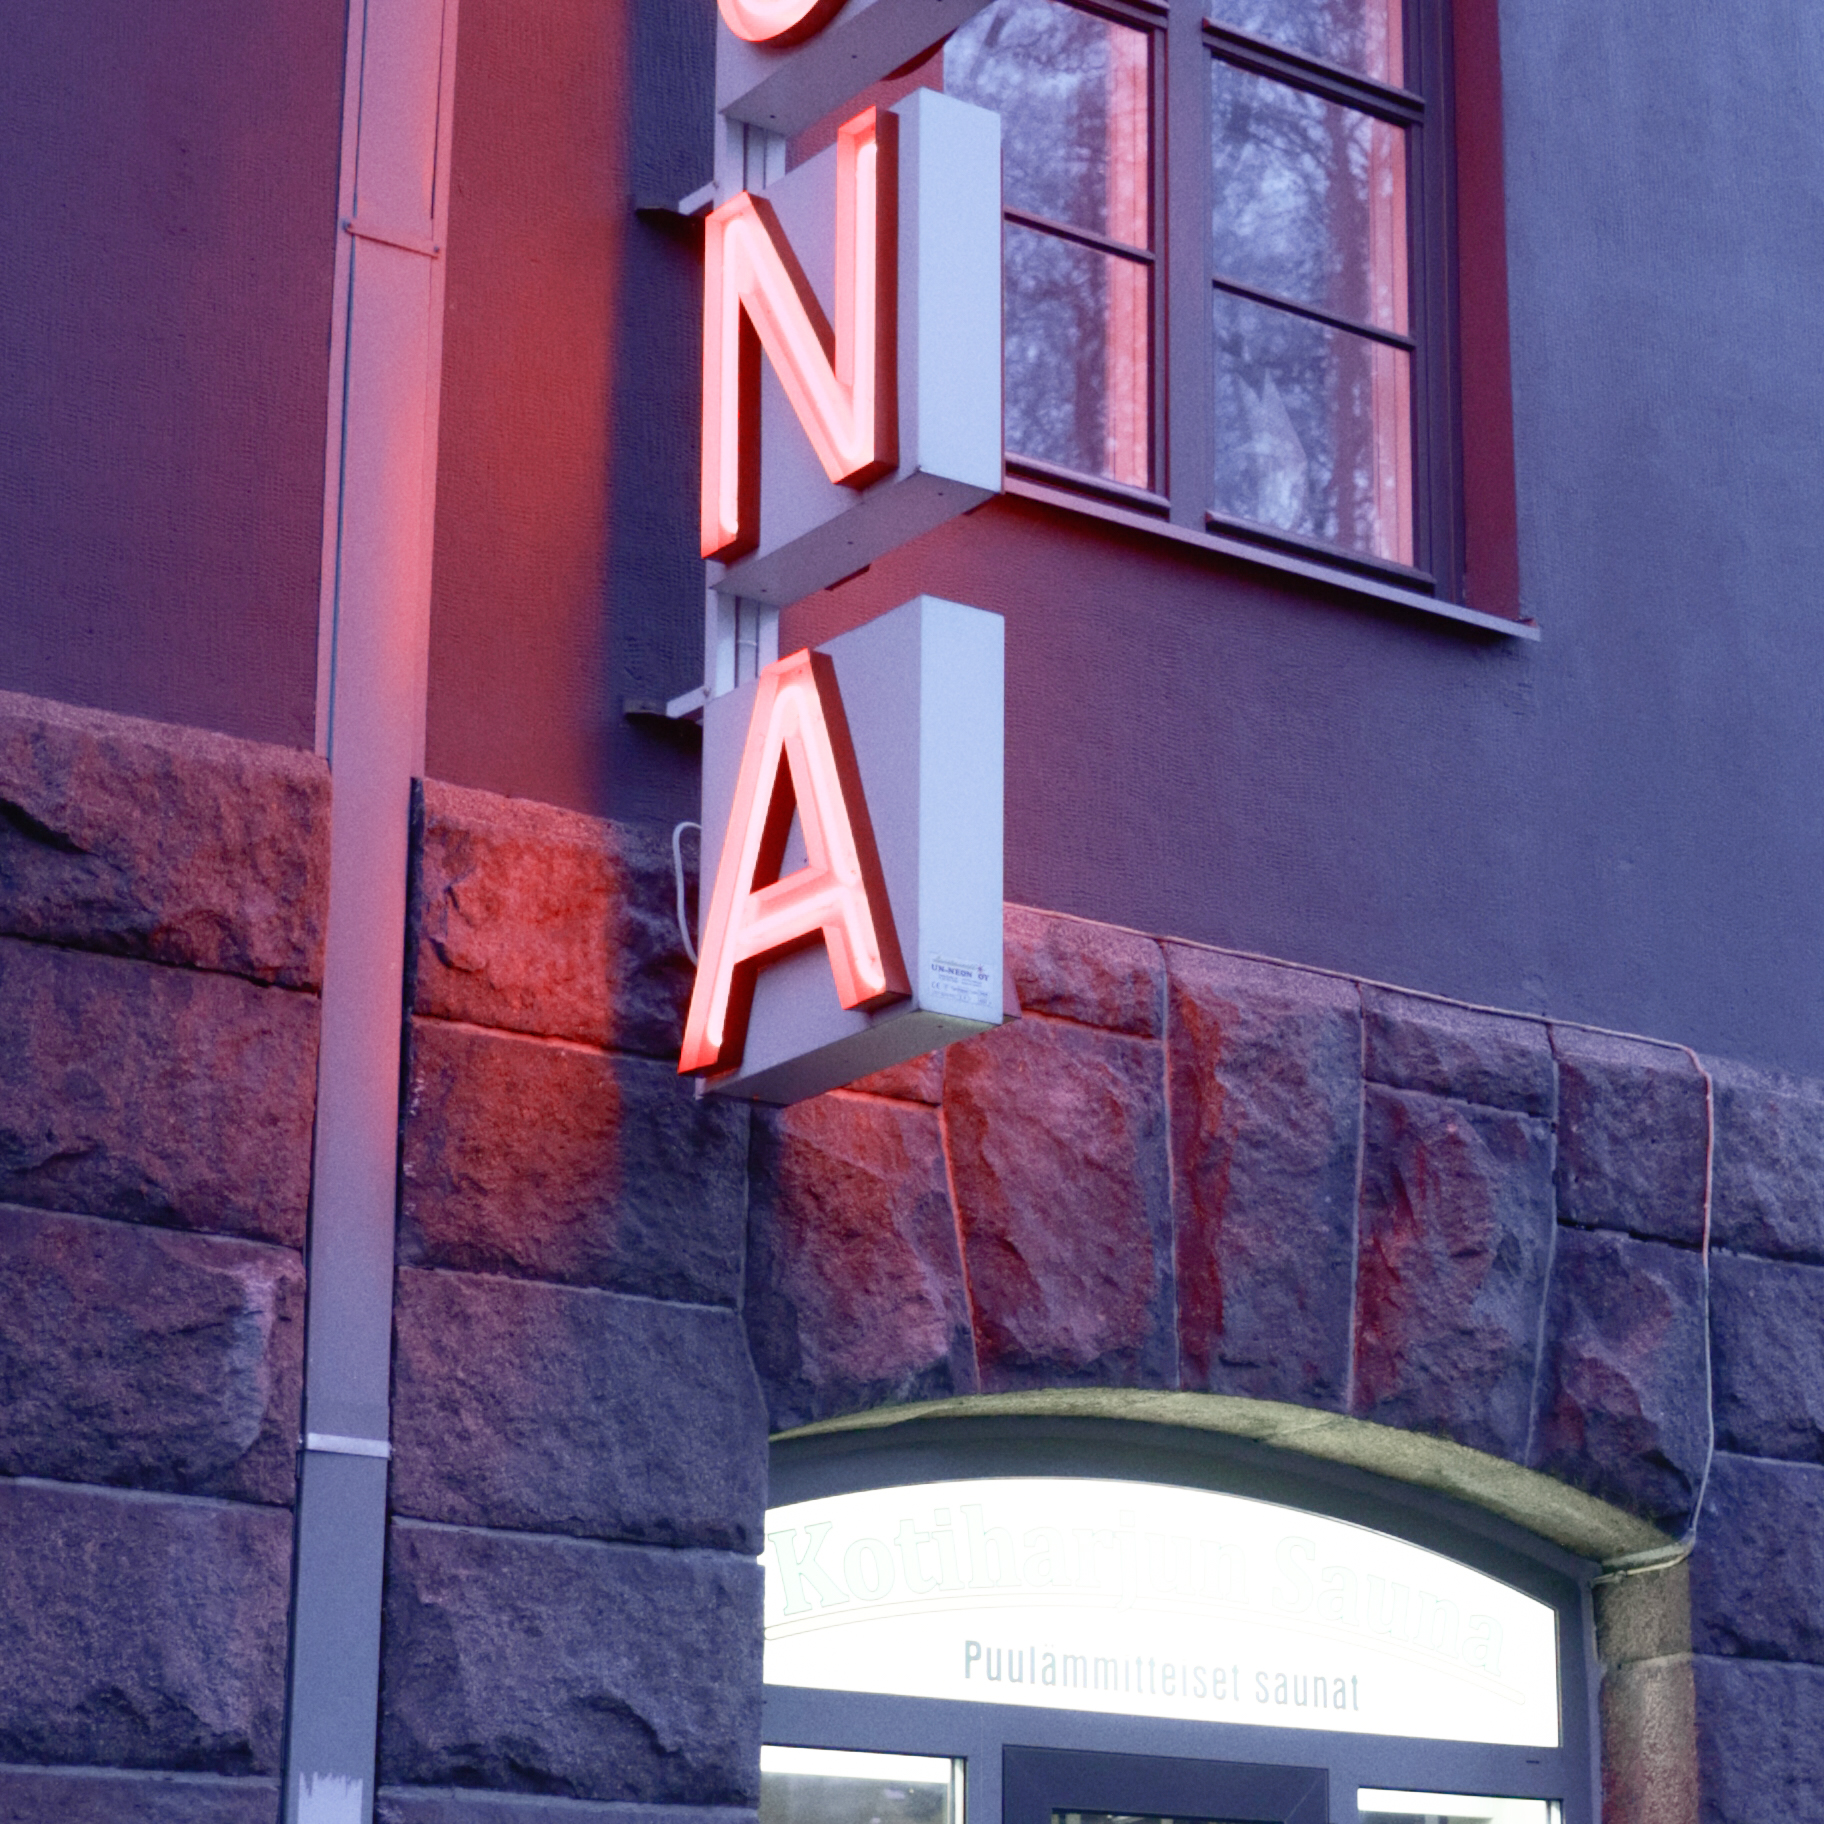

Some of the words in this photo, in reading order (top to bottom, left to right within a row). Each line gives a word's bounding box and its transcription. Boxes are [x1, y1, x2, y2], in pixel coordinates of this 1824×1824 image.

[767, 1504, 1248, 1613] Kotiharjun
[1271, 1534, 1506, 1677] Sauna
[964, 1639, 1241, 1703] Puulämmitteiset
[1254, 1670, 1361, 1712] saunat
